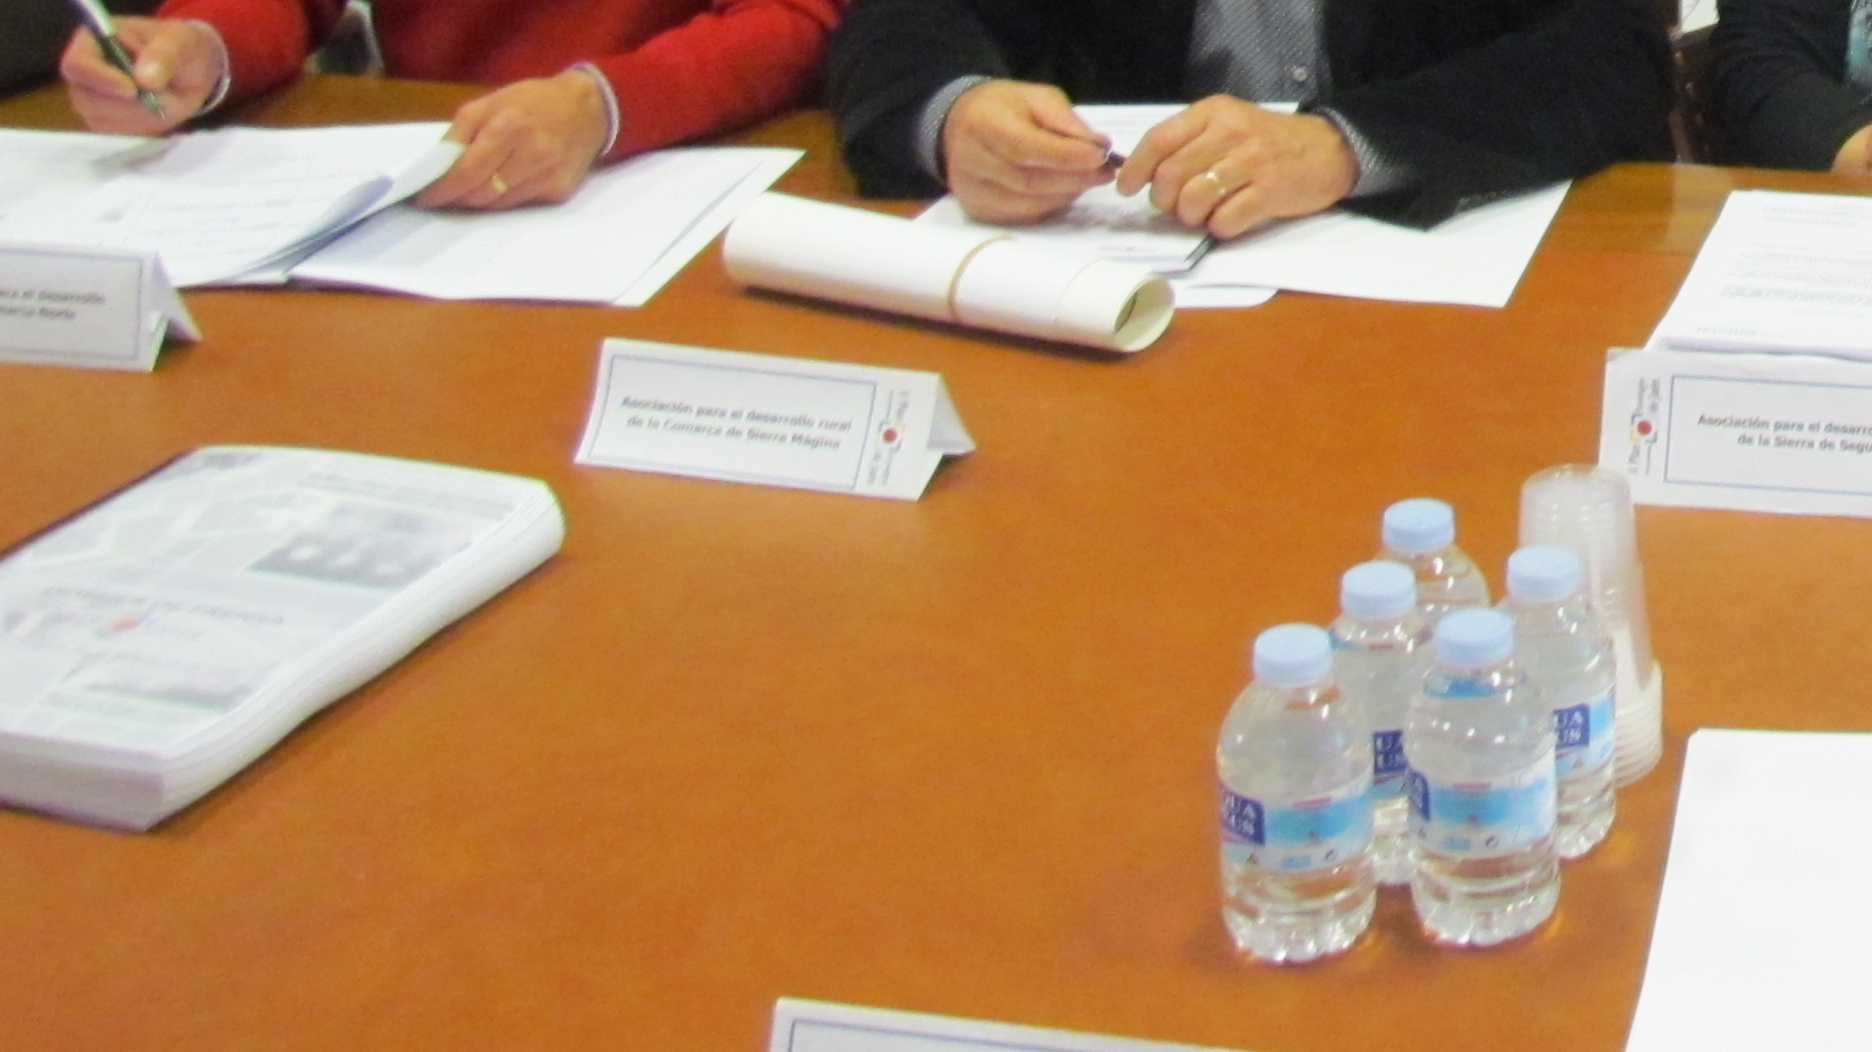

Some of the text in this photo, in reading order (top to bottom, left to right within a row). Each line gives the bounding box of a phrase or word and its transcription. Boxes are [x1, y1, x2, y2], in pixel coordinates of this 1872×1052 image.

[621, 394, 853, 433] Asociación para el desarrollo rural
[1697, 413, 1771, 431] Asociación
[1772, 419, 1805, 435] para
[1807, 420, 1822, 433] el
[626, 414, 645, 427] de
[646, 416, 661, 429] la
[662, 418, 724, 437] Comarca
[725, 425, 744, 438] de
[746, 427, 787, 445] Sierra
[1737, 434, 1755, 446] de
[1757, 434, 1771, 447] la
[1773, 435, 1816, 450] Sierra
[1818, 438, 1836, 451] de
